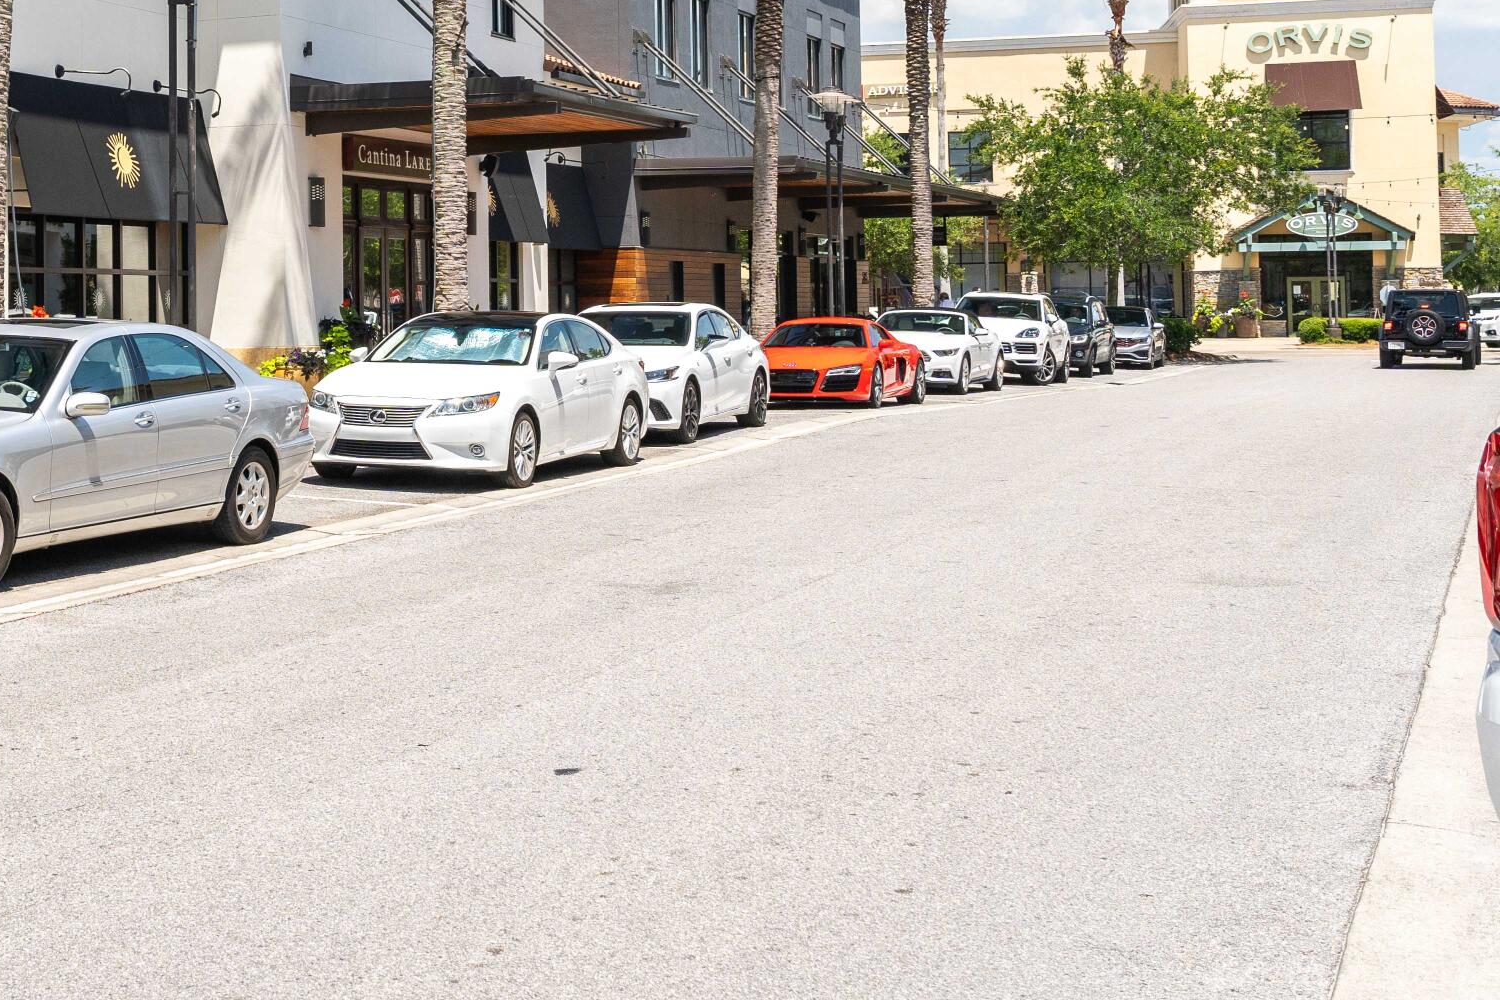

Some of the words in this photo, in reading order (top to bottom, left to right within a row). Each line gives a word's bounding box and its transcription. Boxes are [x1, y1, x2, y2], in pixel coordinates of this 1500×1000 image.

[1247, 23, 1373, 54] ORVIS
[358, 144, 401, 168] Cantina
[404, 150, 431, 171] LARE
